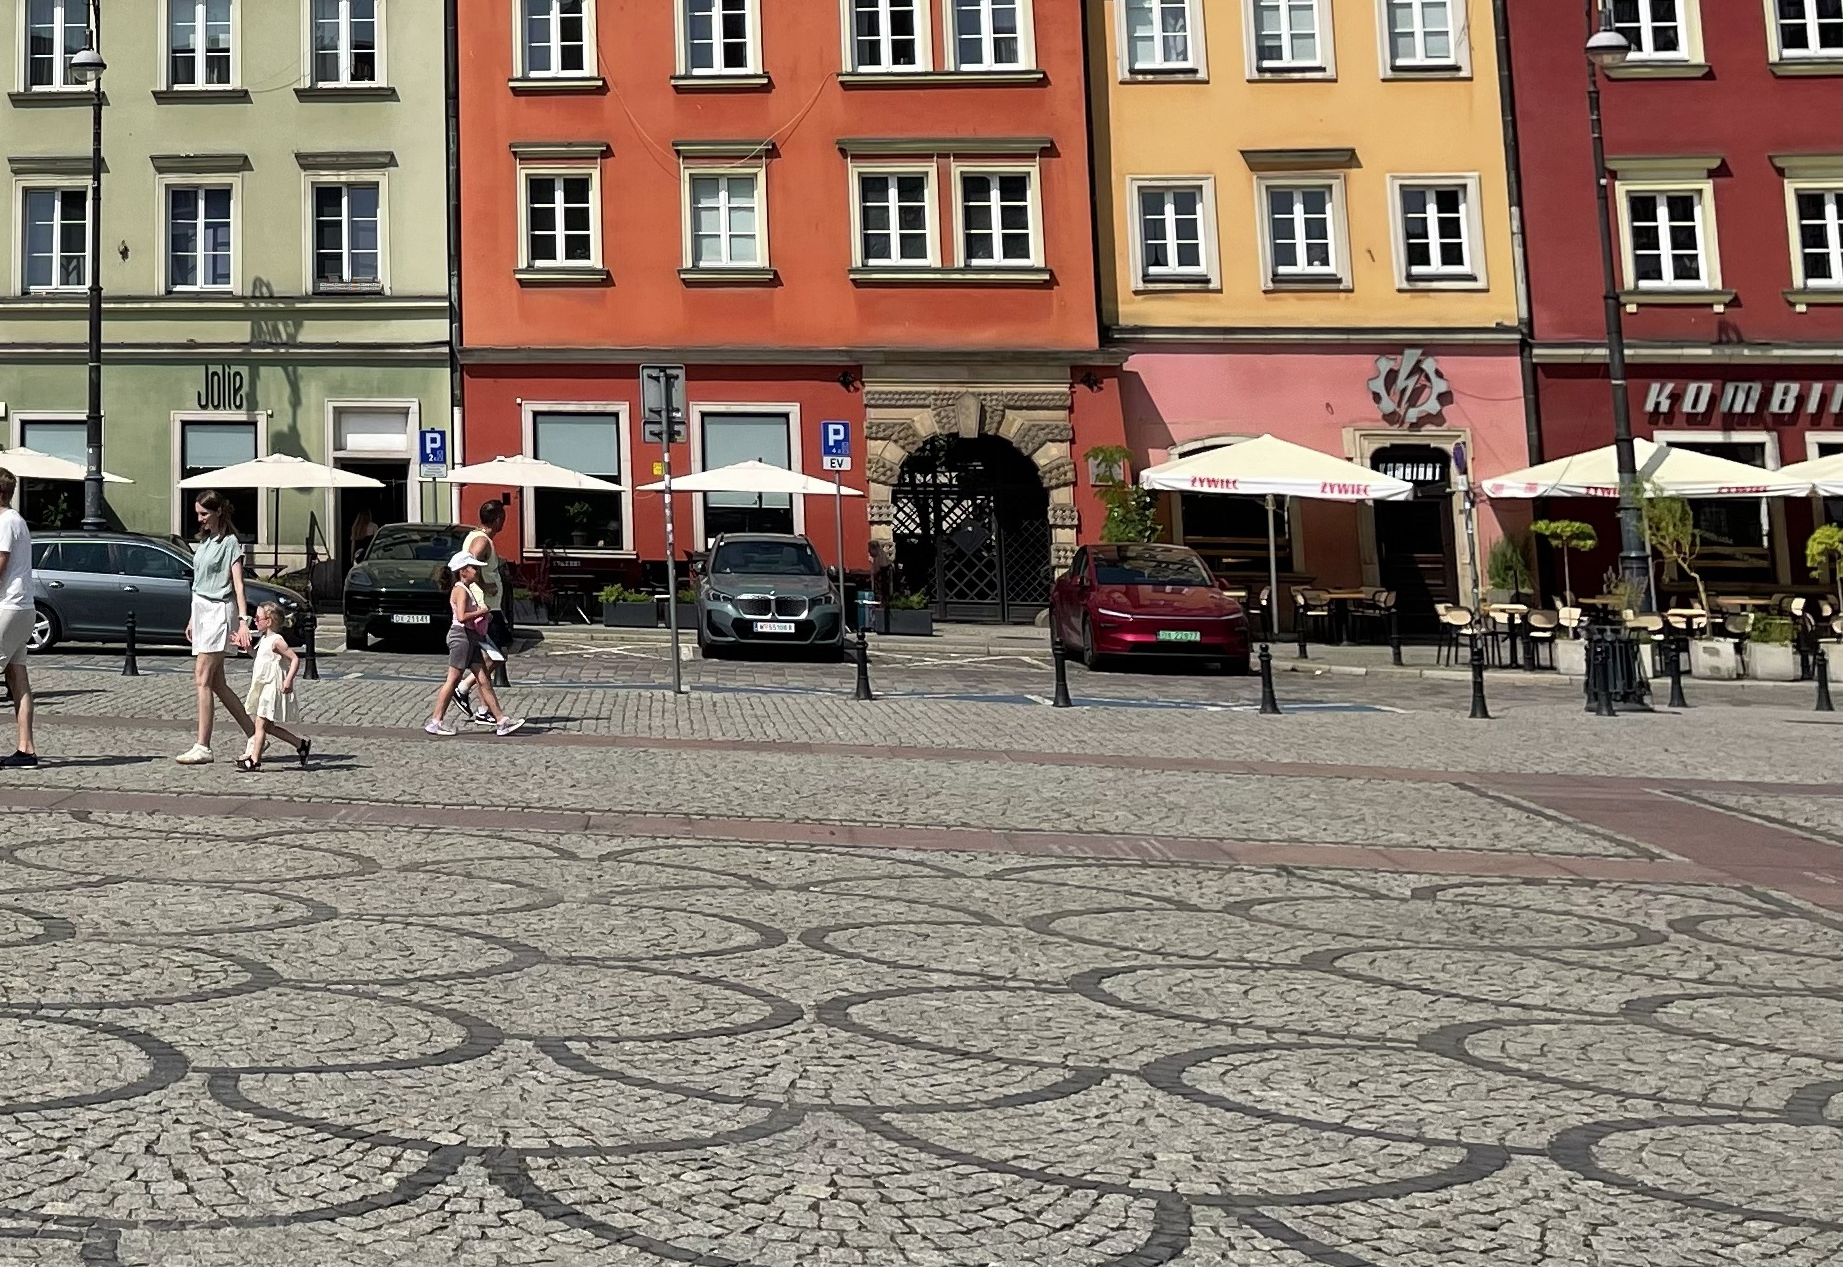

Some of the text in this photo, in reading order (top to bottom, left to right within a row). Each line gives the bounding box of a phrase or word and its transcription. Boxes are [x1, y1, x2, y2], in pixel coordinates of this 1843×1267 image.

[197, 364, 244, 410] Jolie
[426, 433, 441, 454] P
[828, 424, 845, 446] P
[830, 458, 844, 468] EV
